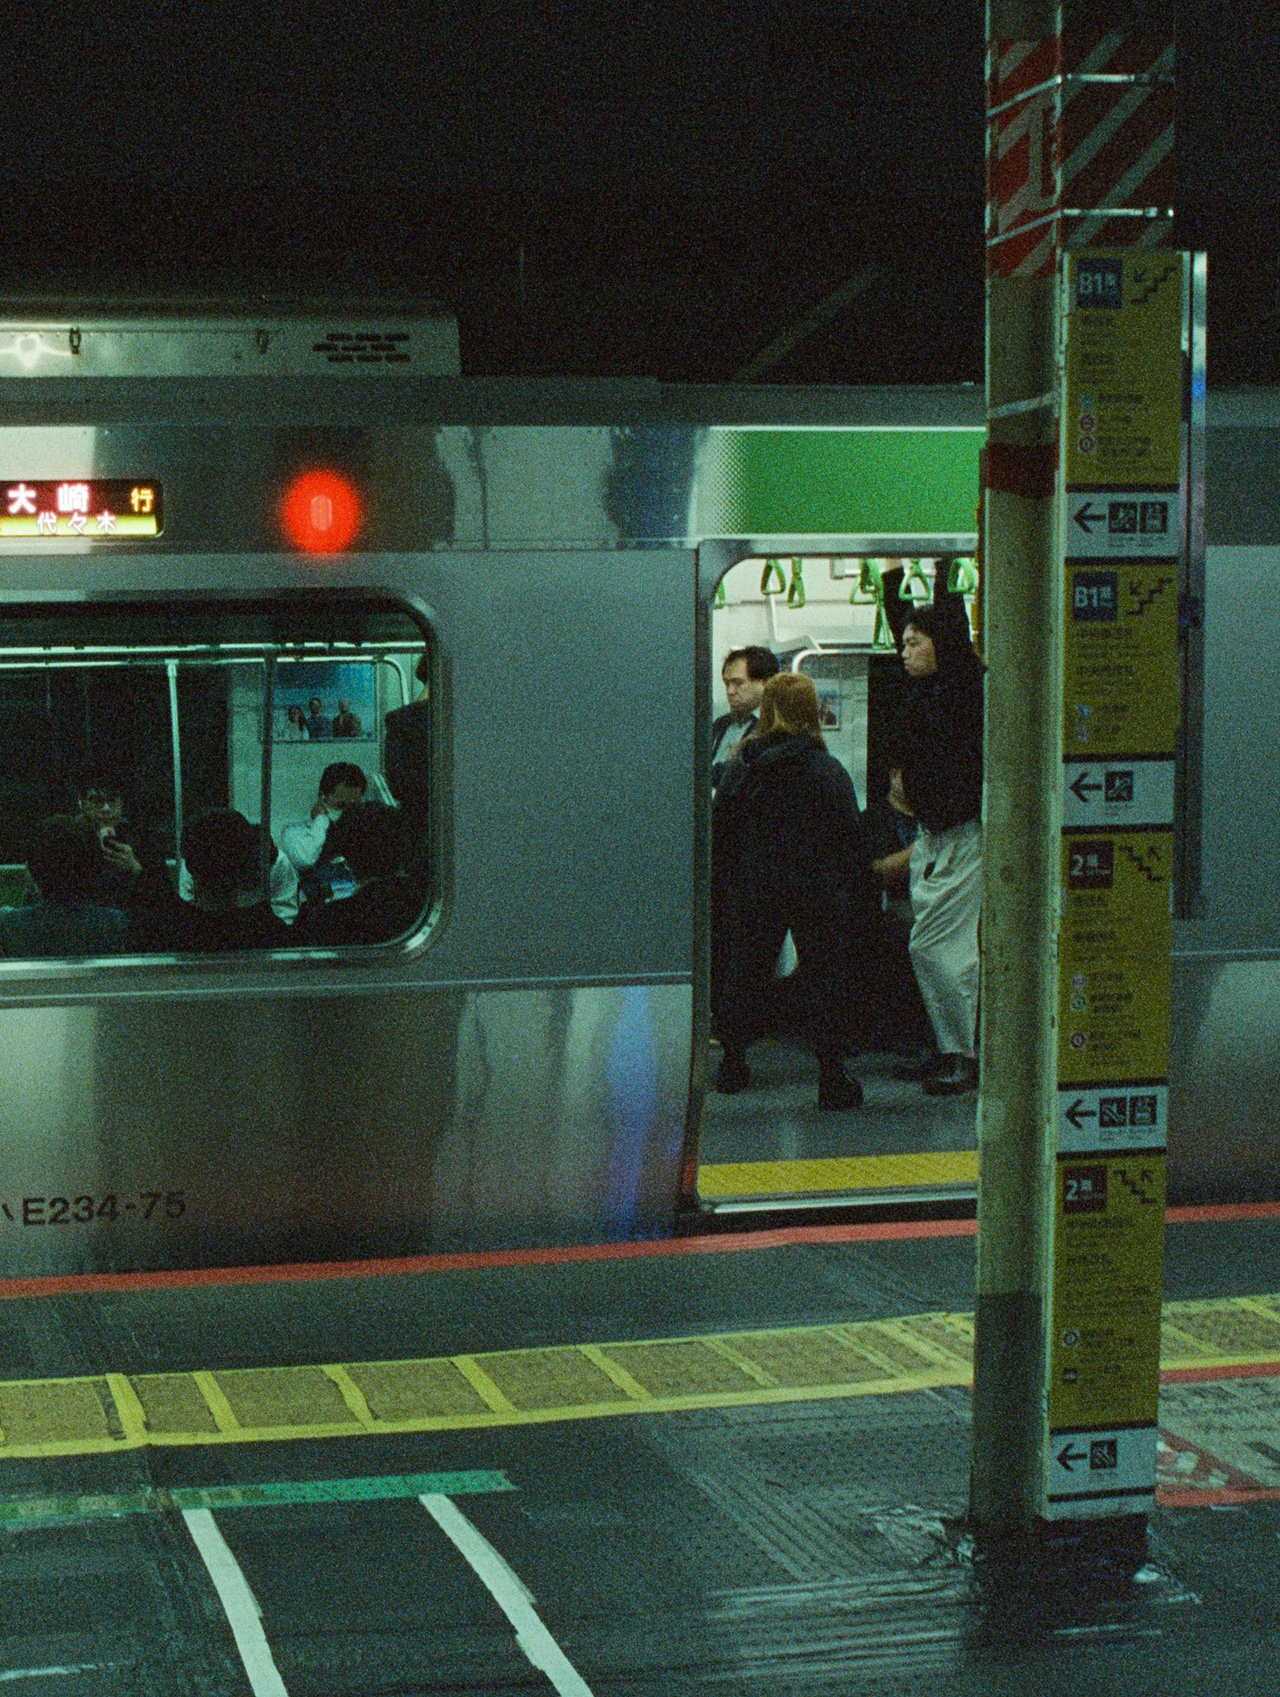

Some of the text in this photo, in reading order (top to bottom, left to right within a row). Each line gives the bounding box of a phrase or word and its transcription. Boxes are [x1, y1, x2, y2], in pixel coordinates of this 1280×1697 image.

[7, 484, 154, 513] 大崎 行
[36, 511, 116, 535] 代々木
